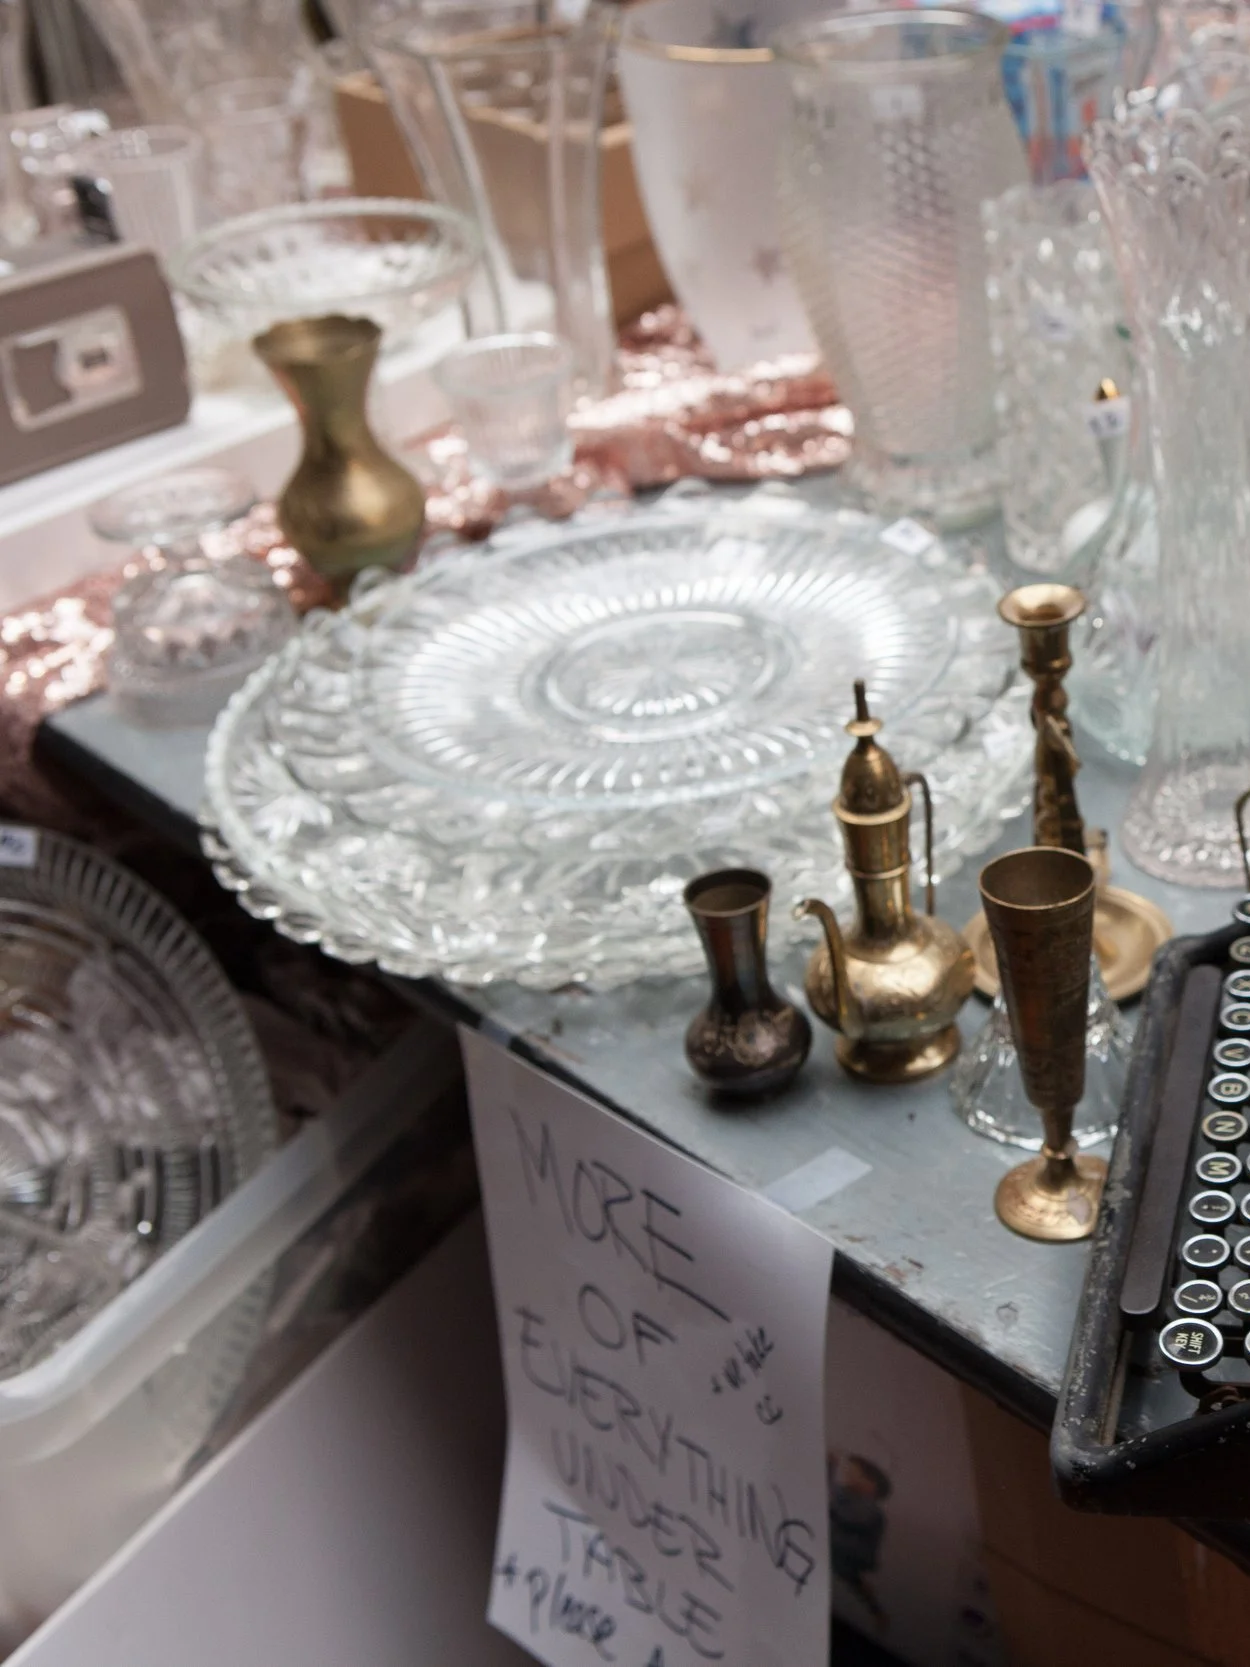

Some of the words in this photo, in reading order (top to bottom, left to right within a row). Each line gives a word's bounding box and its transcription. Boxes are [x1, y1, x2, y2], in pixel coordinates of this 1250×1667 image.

[509, 1108, 732, 1323] MORE
[578, 1284, 677, 1364] OF
[1174, 1332, 1190, 1350] KEY
[1188, 1331, 1205, 1355] SHIFT
[515, 1304, 816, 1597] EVERYTHING
[551, 1427, 736, 1593] UNDER
[543, 1499, 725, 1660] TABLE
